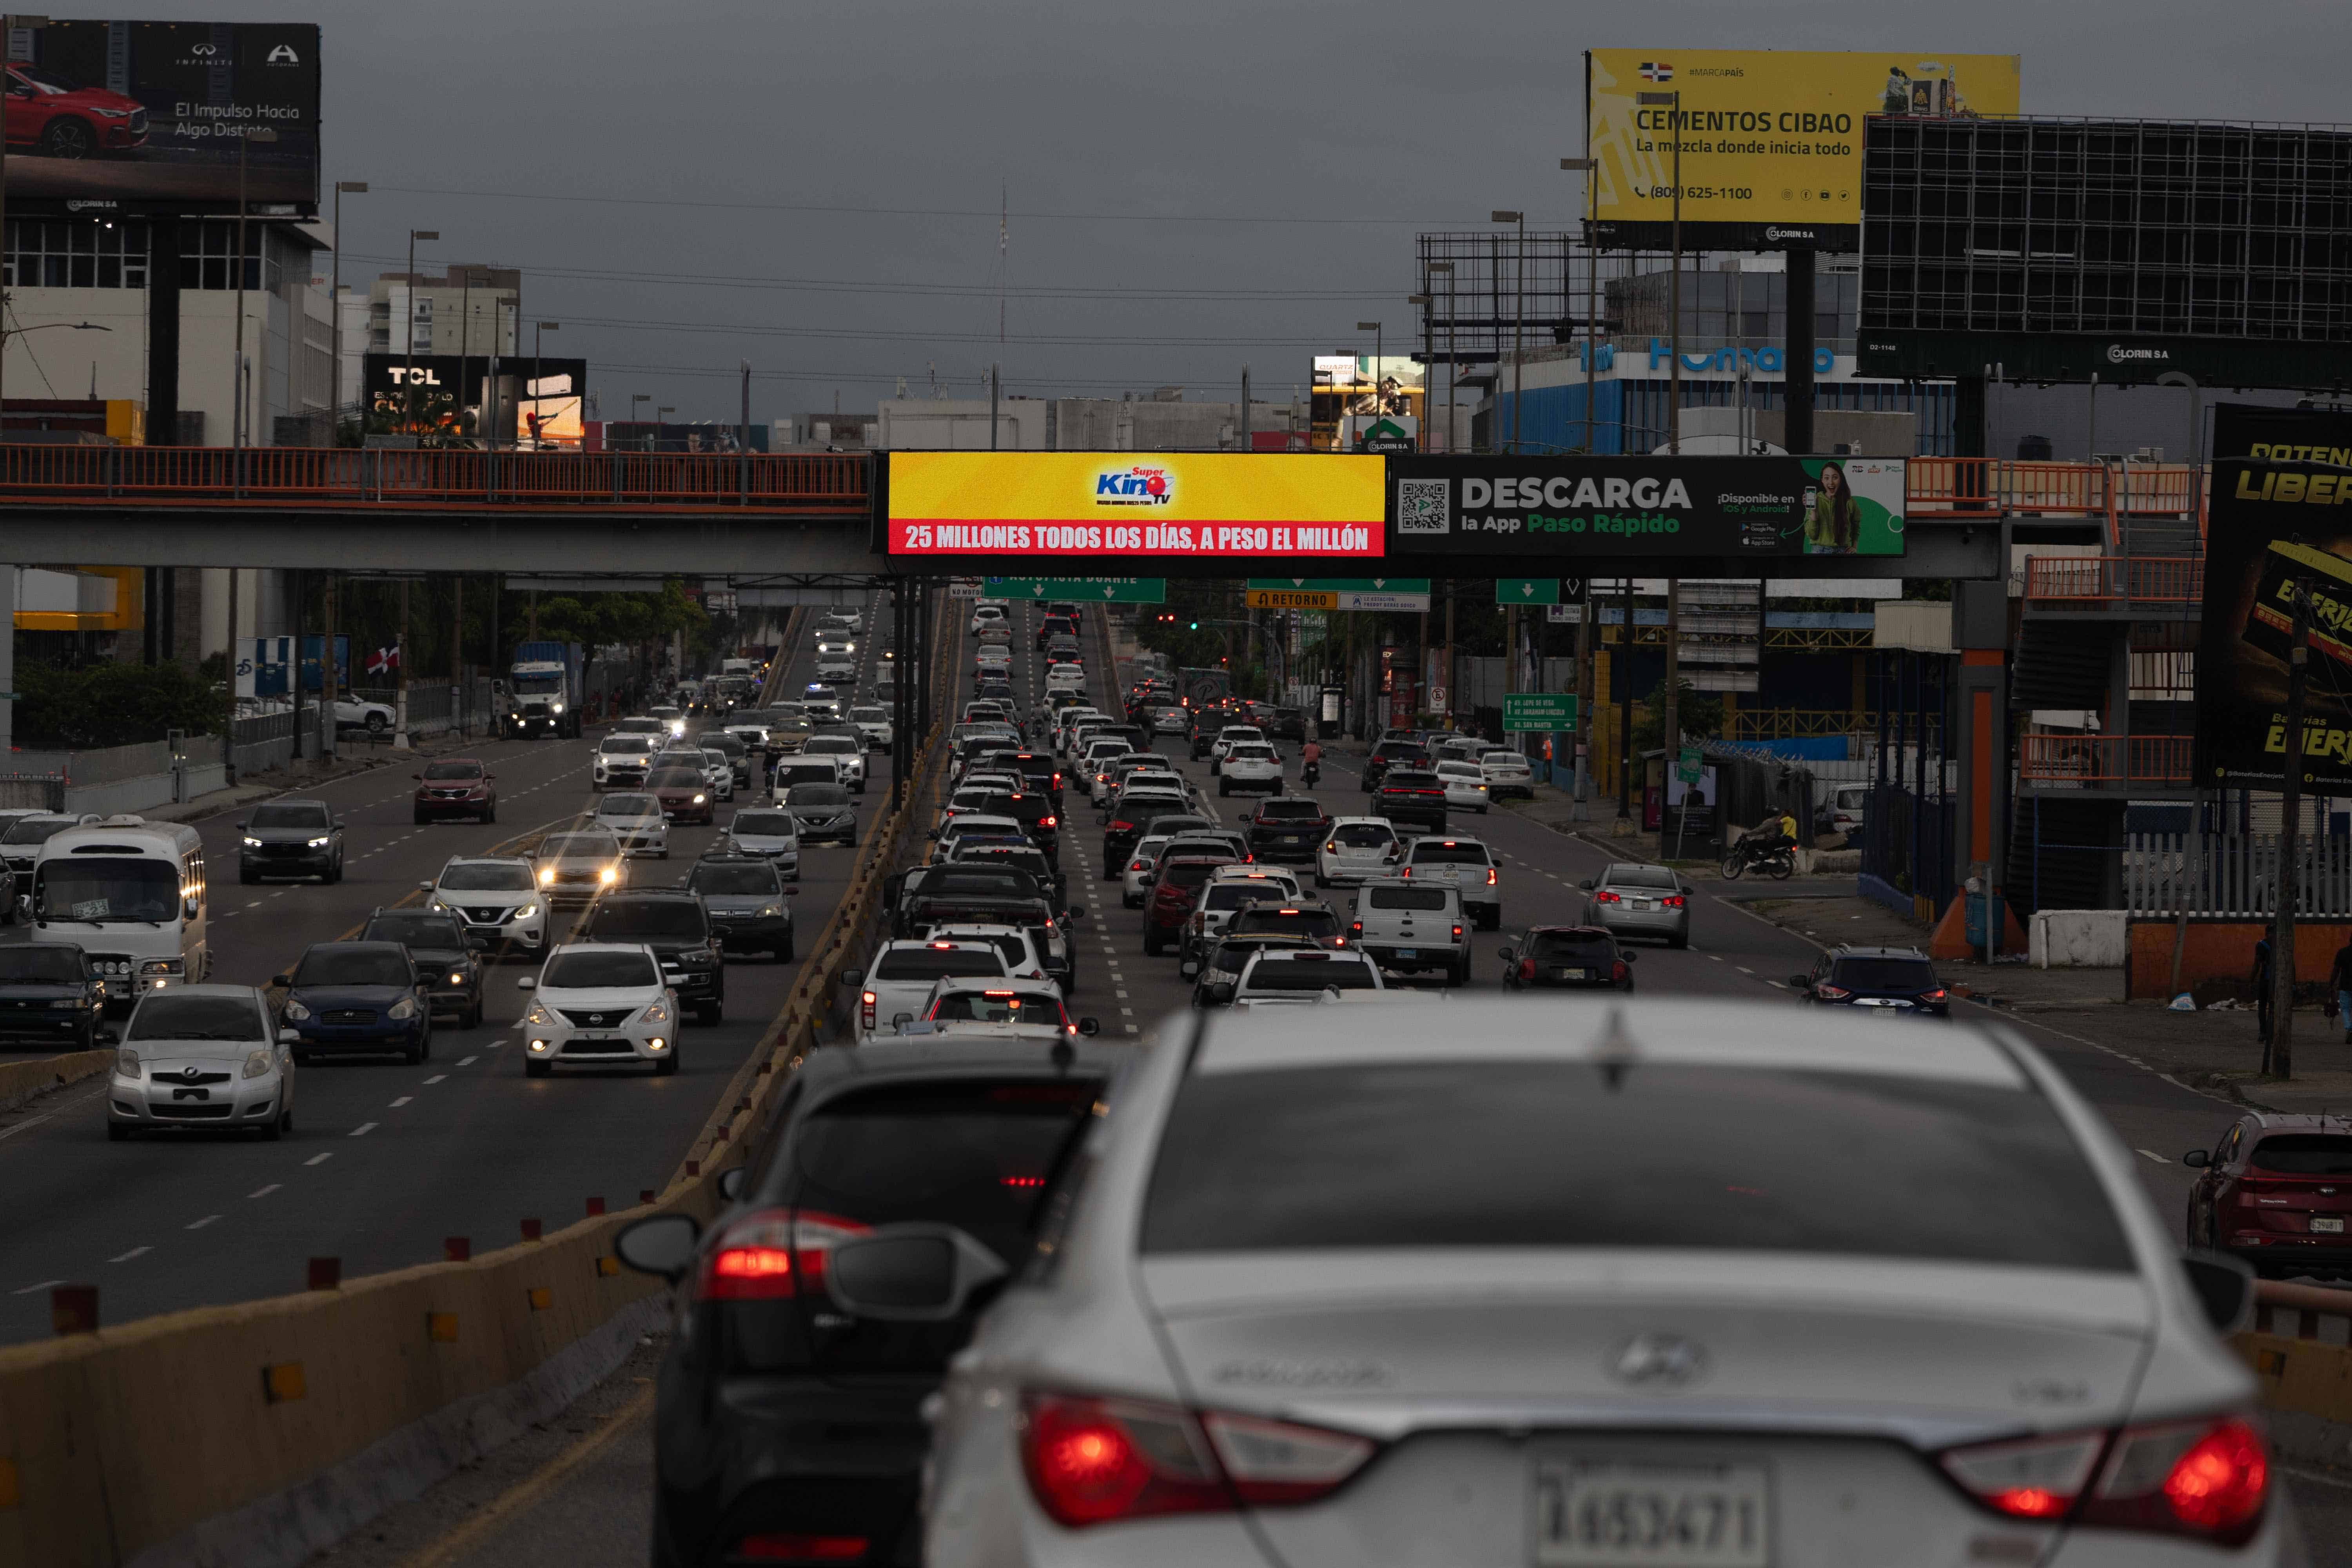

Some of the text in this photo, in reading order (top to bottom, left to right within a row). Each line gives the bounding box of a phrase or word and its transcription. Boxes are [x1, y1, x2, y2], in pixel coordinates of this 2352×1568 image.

[1689, 68, 1744, 78] #MARCAPAÍS
[176, 102, 299, 120] El Impulso Hacia
[174, 122, 210, 139] Algo
[1637, 110, 1851, 134] CEMENTOS CIBAO
[1637, 138, 1653, 152] La
[1717, 140, 1765, 154] donde
[1769, 141, 1810, 154] inicia
[1815, 142, 1850, 155] todo
[1688, 187, 1752, 199] 625-1100
[2107, 344, 2153, 363] COLORIN
[388, 367, 441, 385] TCL
[2250, 443, 2352, 467] POTEN
[1132, 467, 1165, 477] Super
[1154, 494, 1171, 504] TV
[1461, 476, 1693, 509] DESCARGA
[1717, 493, 1779, 505] ¡Disponible
[1749, 505, 1790, 513] Android!
[1462, 512, 1680, 537] la App Paso Rápido
[906, 523, 1368, 551] 25 MILLONES TODOS LOS DÍAS, A PESO EL MILLÓN
[1272, 594, 1327, 606] RETORNO
[2271, 713, 2327, 726] Barías
